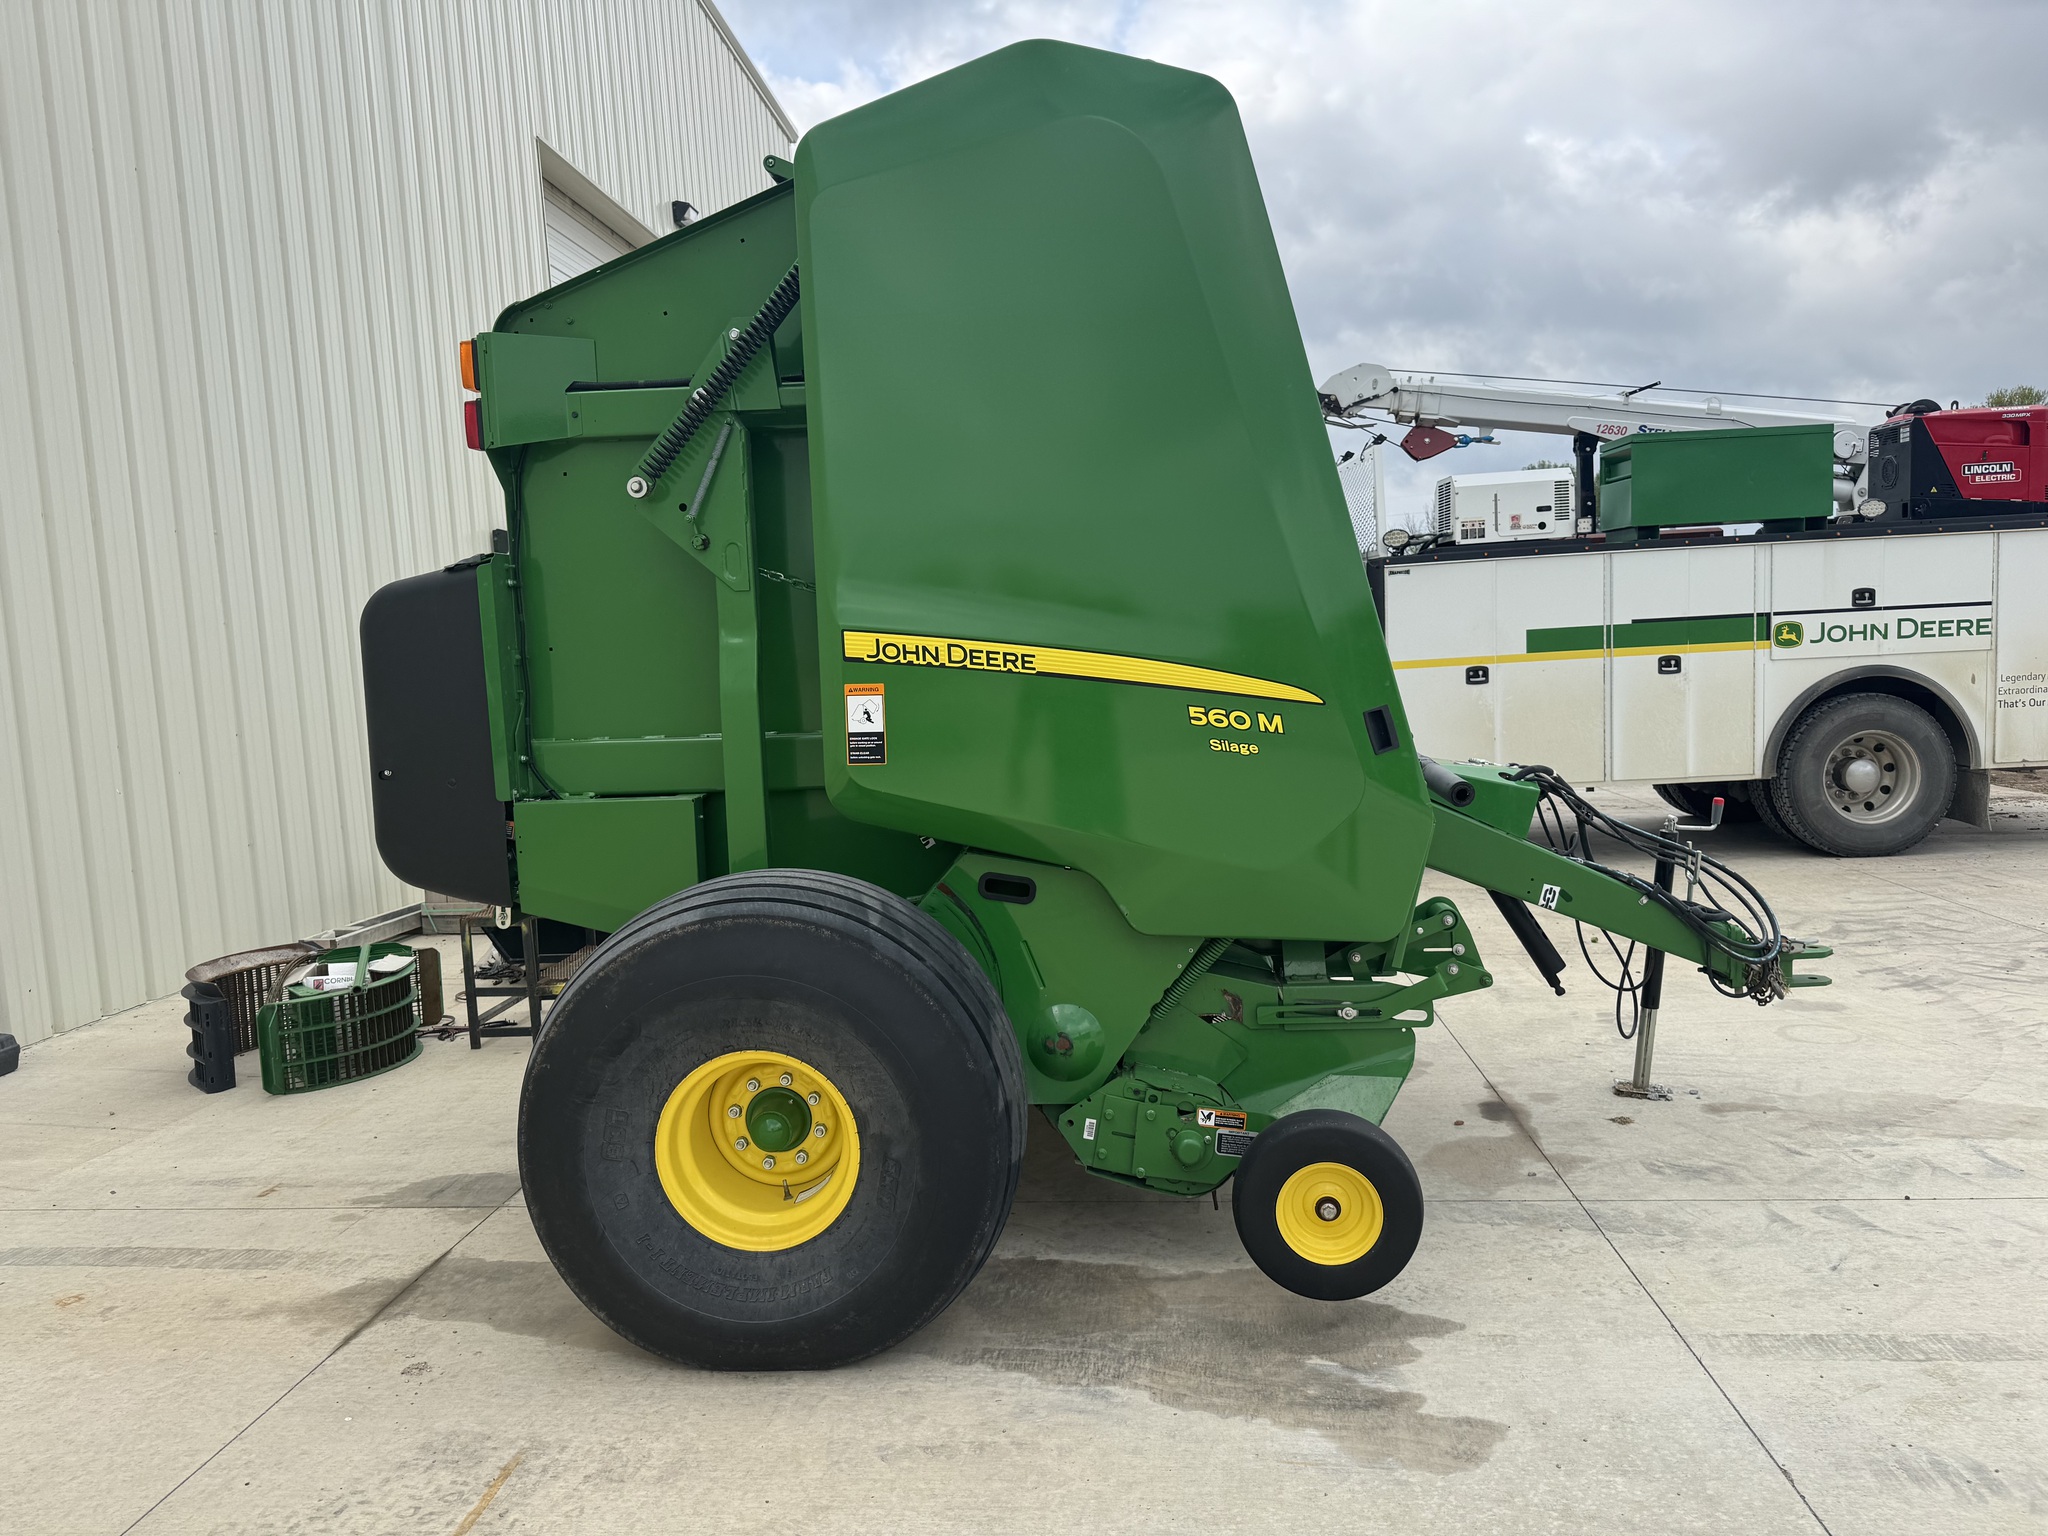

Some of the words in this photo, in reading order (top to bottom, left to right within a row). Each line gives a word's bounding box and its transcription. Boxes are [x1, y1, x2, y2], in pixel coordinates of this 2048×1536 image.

[1595, 423, 1628, 436] 12630
[1964, 464, 2011, 474] LINCOLN
[1975, 473, 2016, 482] ELECTRIC
[1809, 621, 1889, 644] JOHN
[1896, 617, 1992, 640] DEERE
[866, 638, 941, 665] JOHN
[946, 643, 1037, 672] DEERE
[2000, 671, 2046, 684] Legendary
[1997, 685, 2048, 695] Extraordina
[2028, 697, 2046, 707] Our
[1187, 704, 1252, 731] 560
[1257, 712, 1285, 734] M
[1209, 737, 1260, 756] Silage
